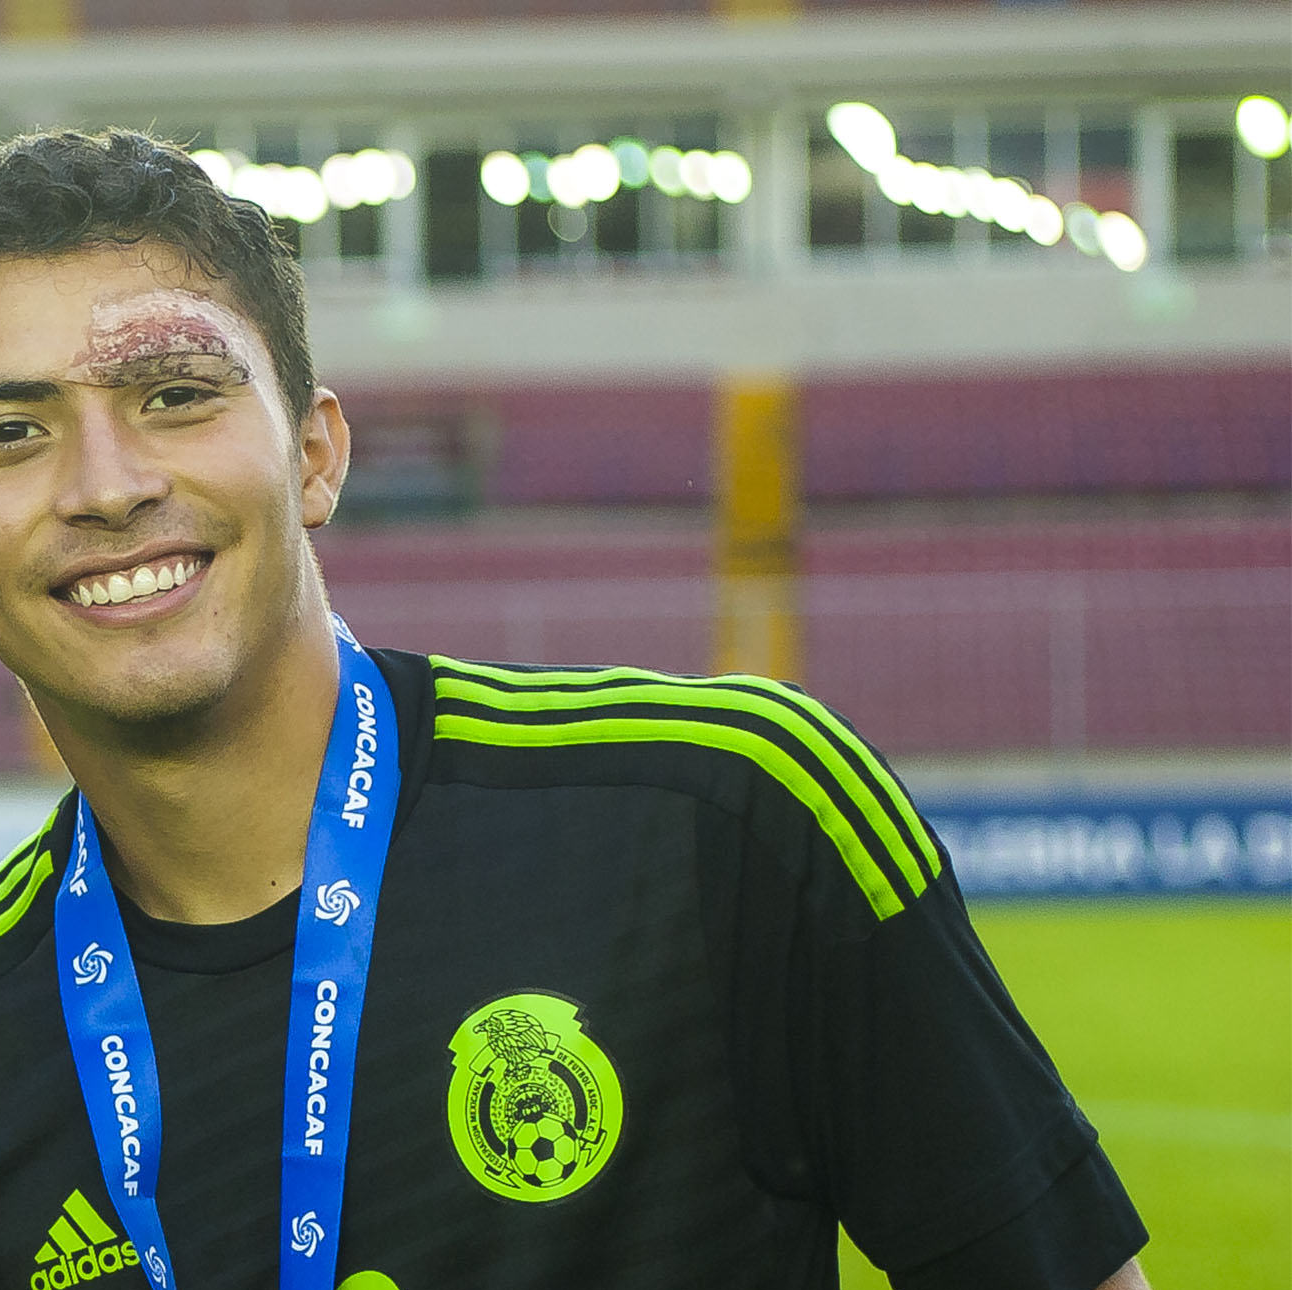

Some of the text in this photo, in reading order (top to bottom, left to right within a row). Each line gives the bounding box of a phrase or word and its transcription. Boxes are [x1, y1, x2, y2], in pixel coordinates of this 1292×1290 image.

[343, 682, 378, 829] CONCACAF
[70, 790, 88, 897] CACAF
[101, 1034, 138, 1197] CONCACAF
[305, 980, 338, 1156] CONCACAF
